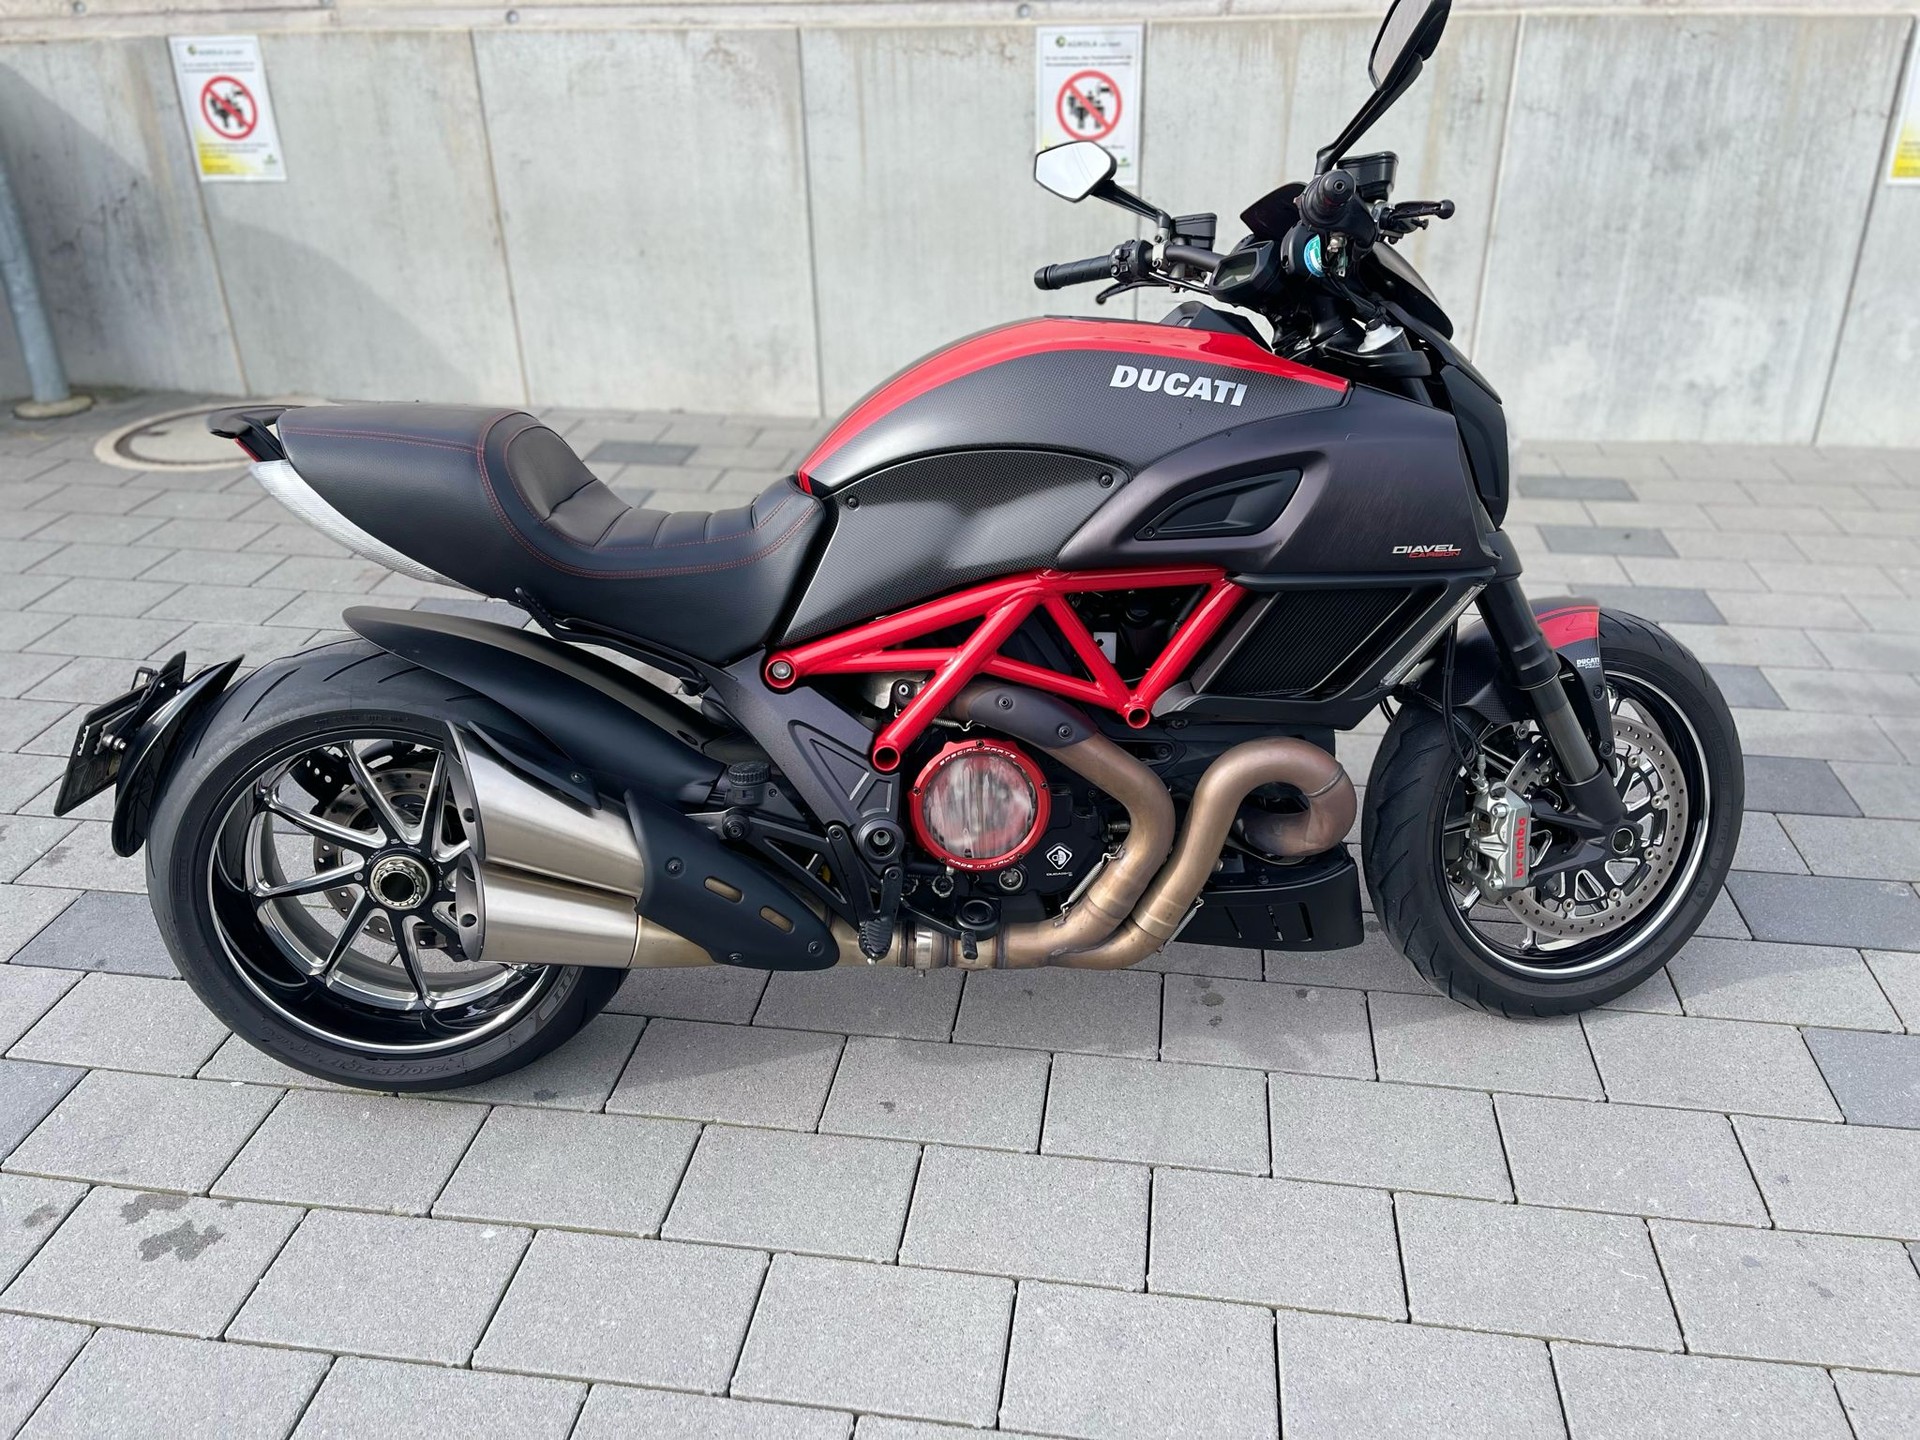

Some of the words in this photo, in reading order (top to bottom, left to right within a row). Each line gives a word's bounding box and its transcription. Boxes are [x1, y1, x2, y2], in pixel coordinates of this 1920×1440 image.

[1109, 364, 1248, 407] DUCATI
[1392, 544, 1462, 554] DIAVEL
[1577, 657, 1600, 666] DUCATI
[940, 747, 979, 766] SPECIAL
[982, 746, 1017, 759] PARTS
[1513, 816, 1527, 879] brembo
